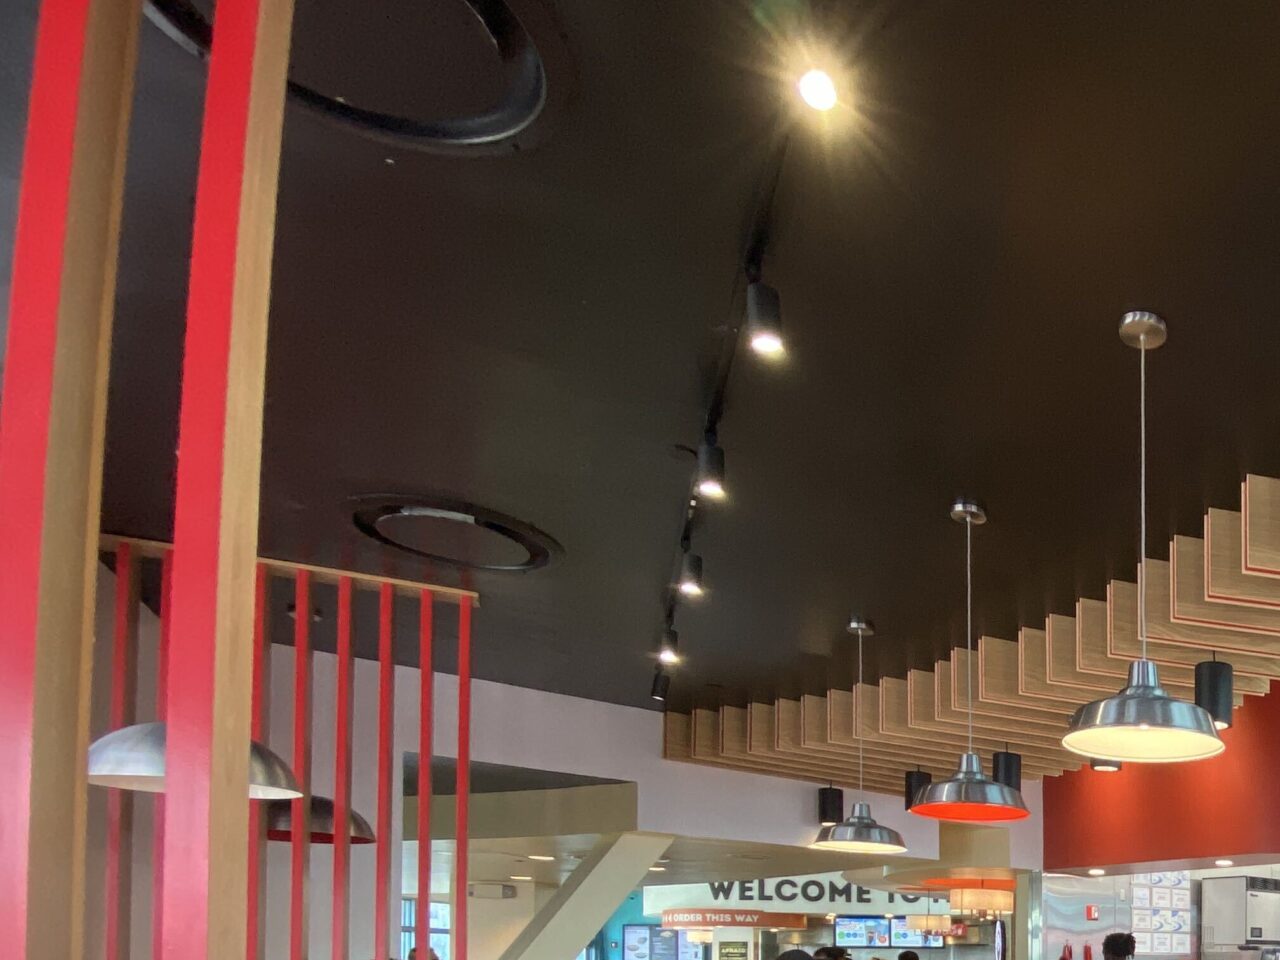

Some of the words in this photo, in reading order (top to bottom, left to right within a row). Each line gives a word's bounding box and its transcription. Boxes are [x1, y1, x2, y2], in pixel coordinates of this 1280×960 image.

[708, 879, 872, 903] WELCOME
[673, 913, 703, 923] ORDER
[705, 914, 732, 923] THIS
[735, 914, 760, 923] WAY
